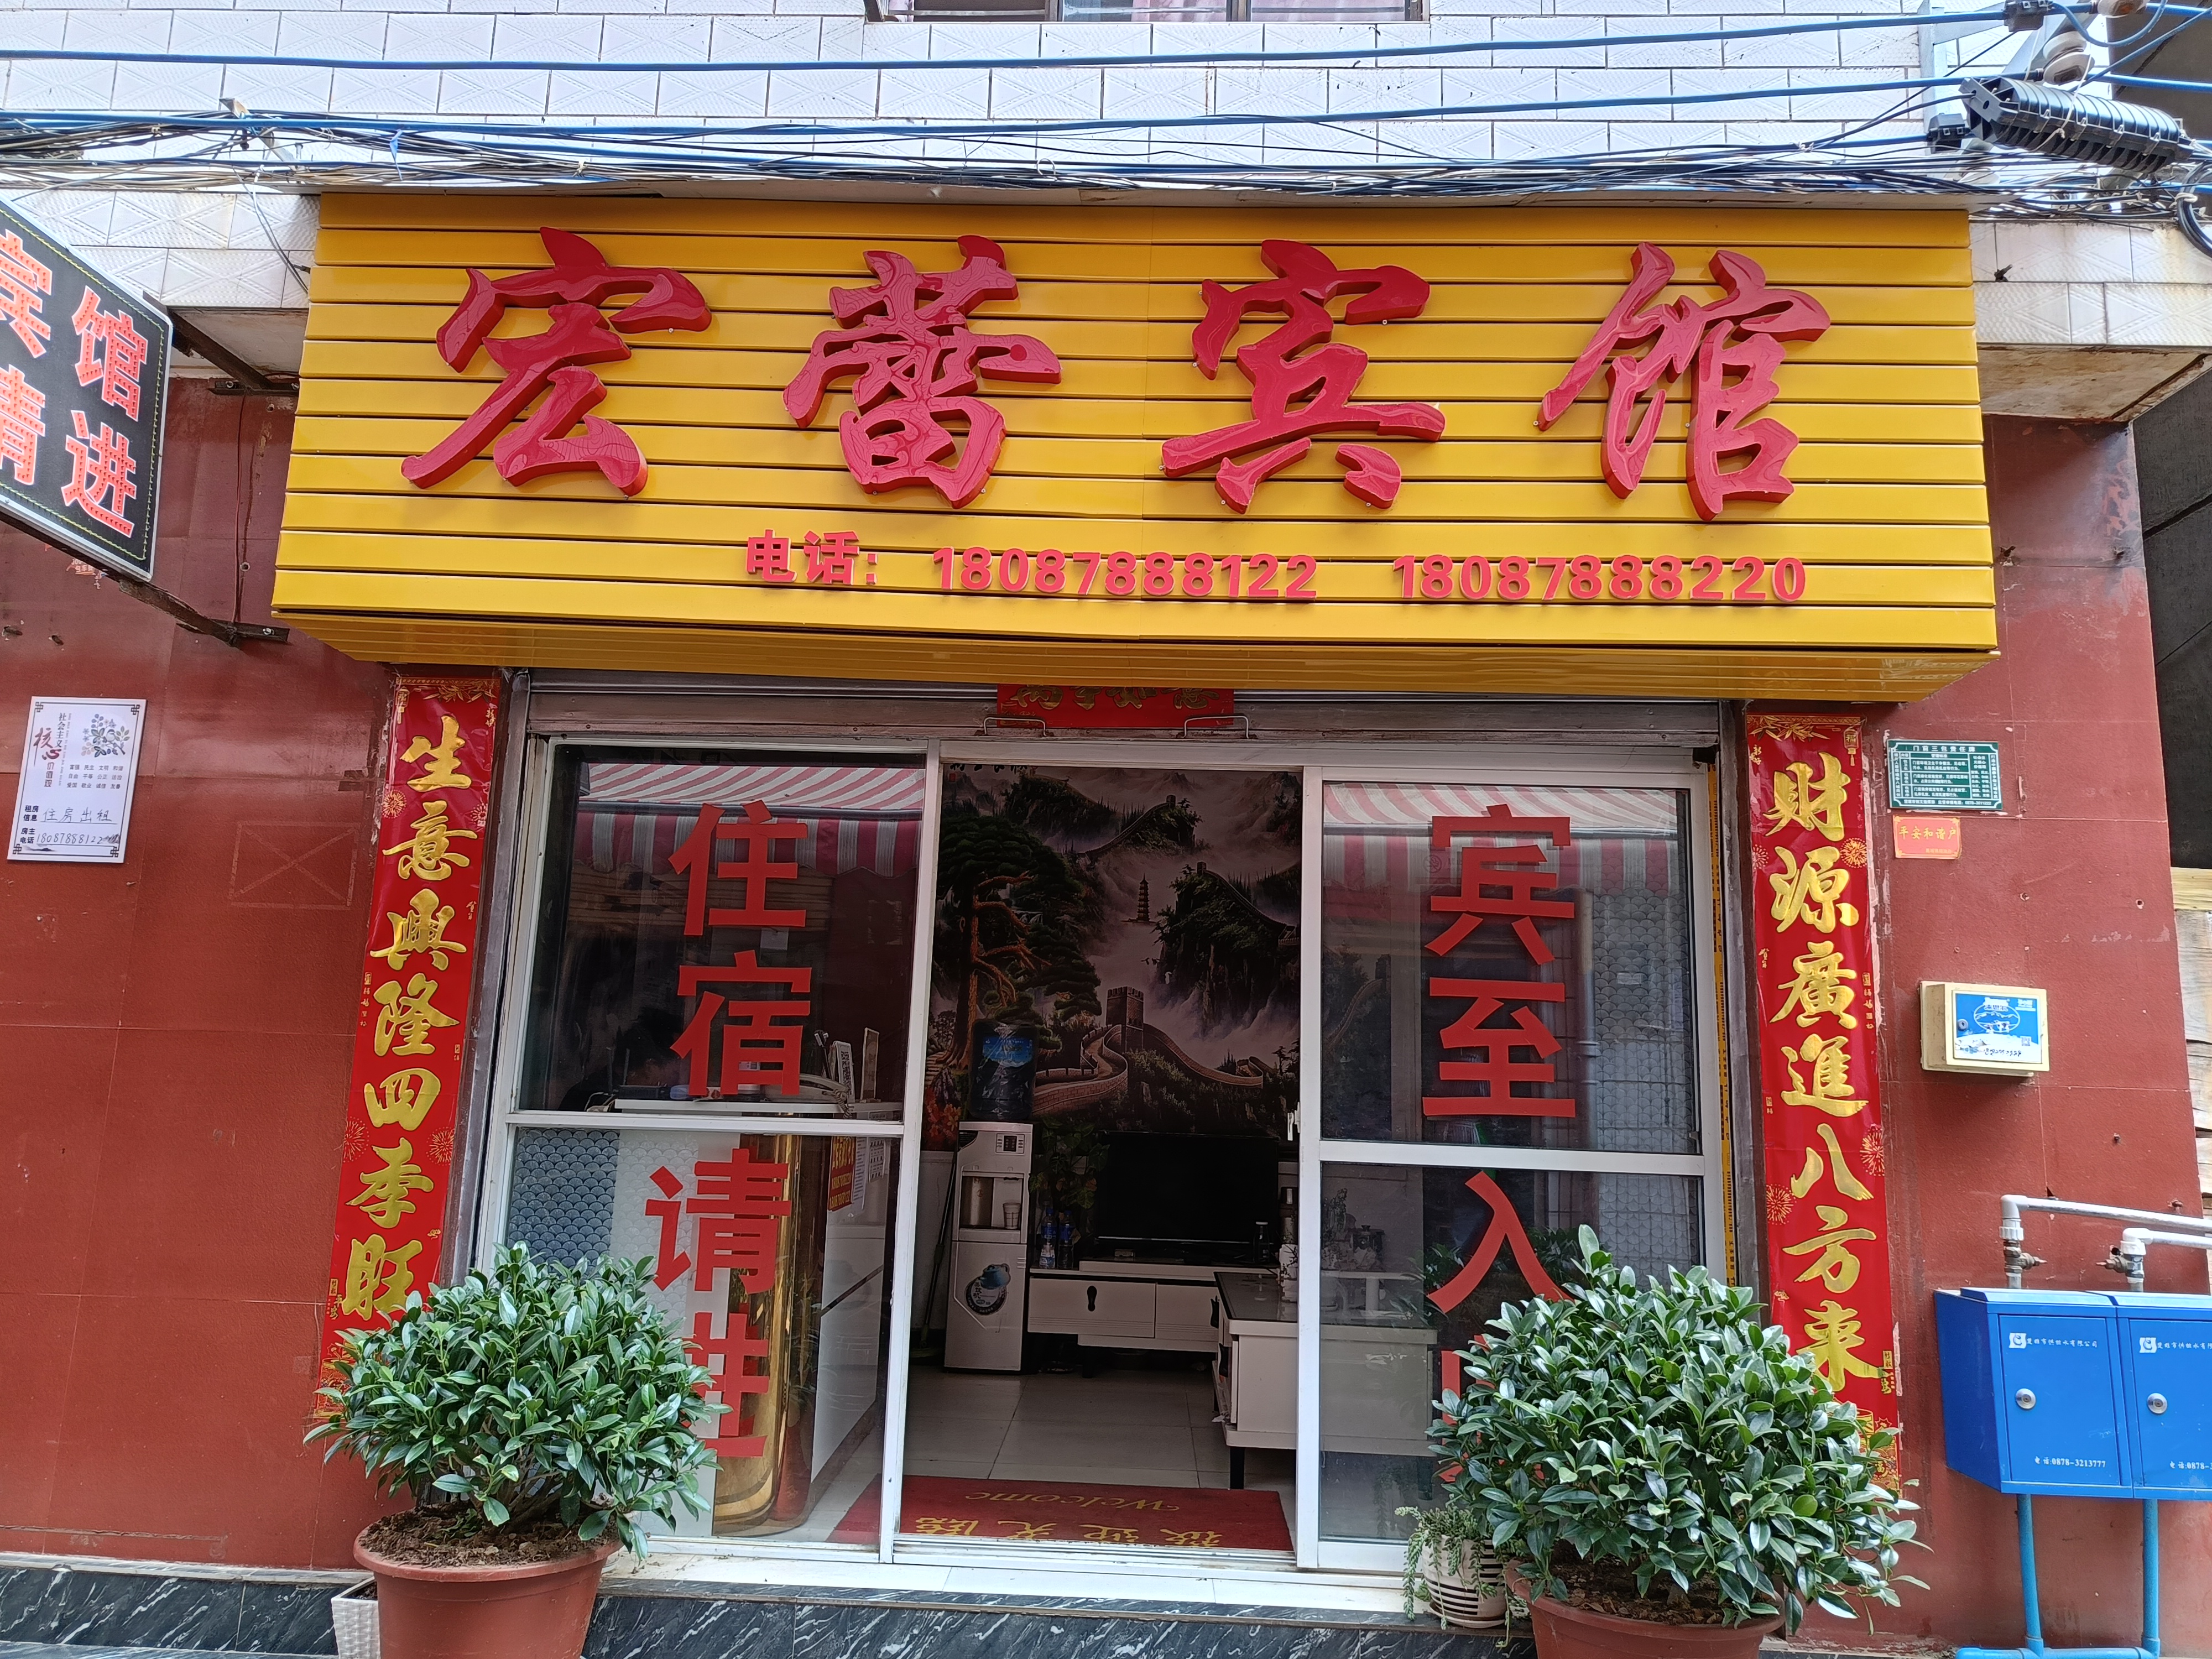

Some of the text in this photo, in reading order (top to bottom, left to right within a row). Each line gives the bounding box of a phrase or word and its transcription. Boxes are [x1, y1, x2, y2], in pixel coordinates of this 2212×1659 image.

[932, 546, 1318, 600] 18087888122
[1392, 554, 1807, 603] 18087888220
[56, 712, 67, 748] 社会主义
[33, 727, 62, 766] 核心
[44, 762, 55, 787] 价值观
[36, 832, 103, 844] 18087888122
[1898, 825, 1957, 840] 平安和谐户
[1422, 804, 1576, 1482] 宾至入
[965, 1491, 1180, 1512] Welcome
